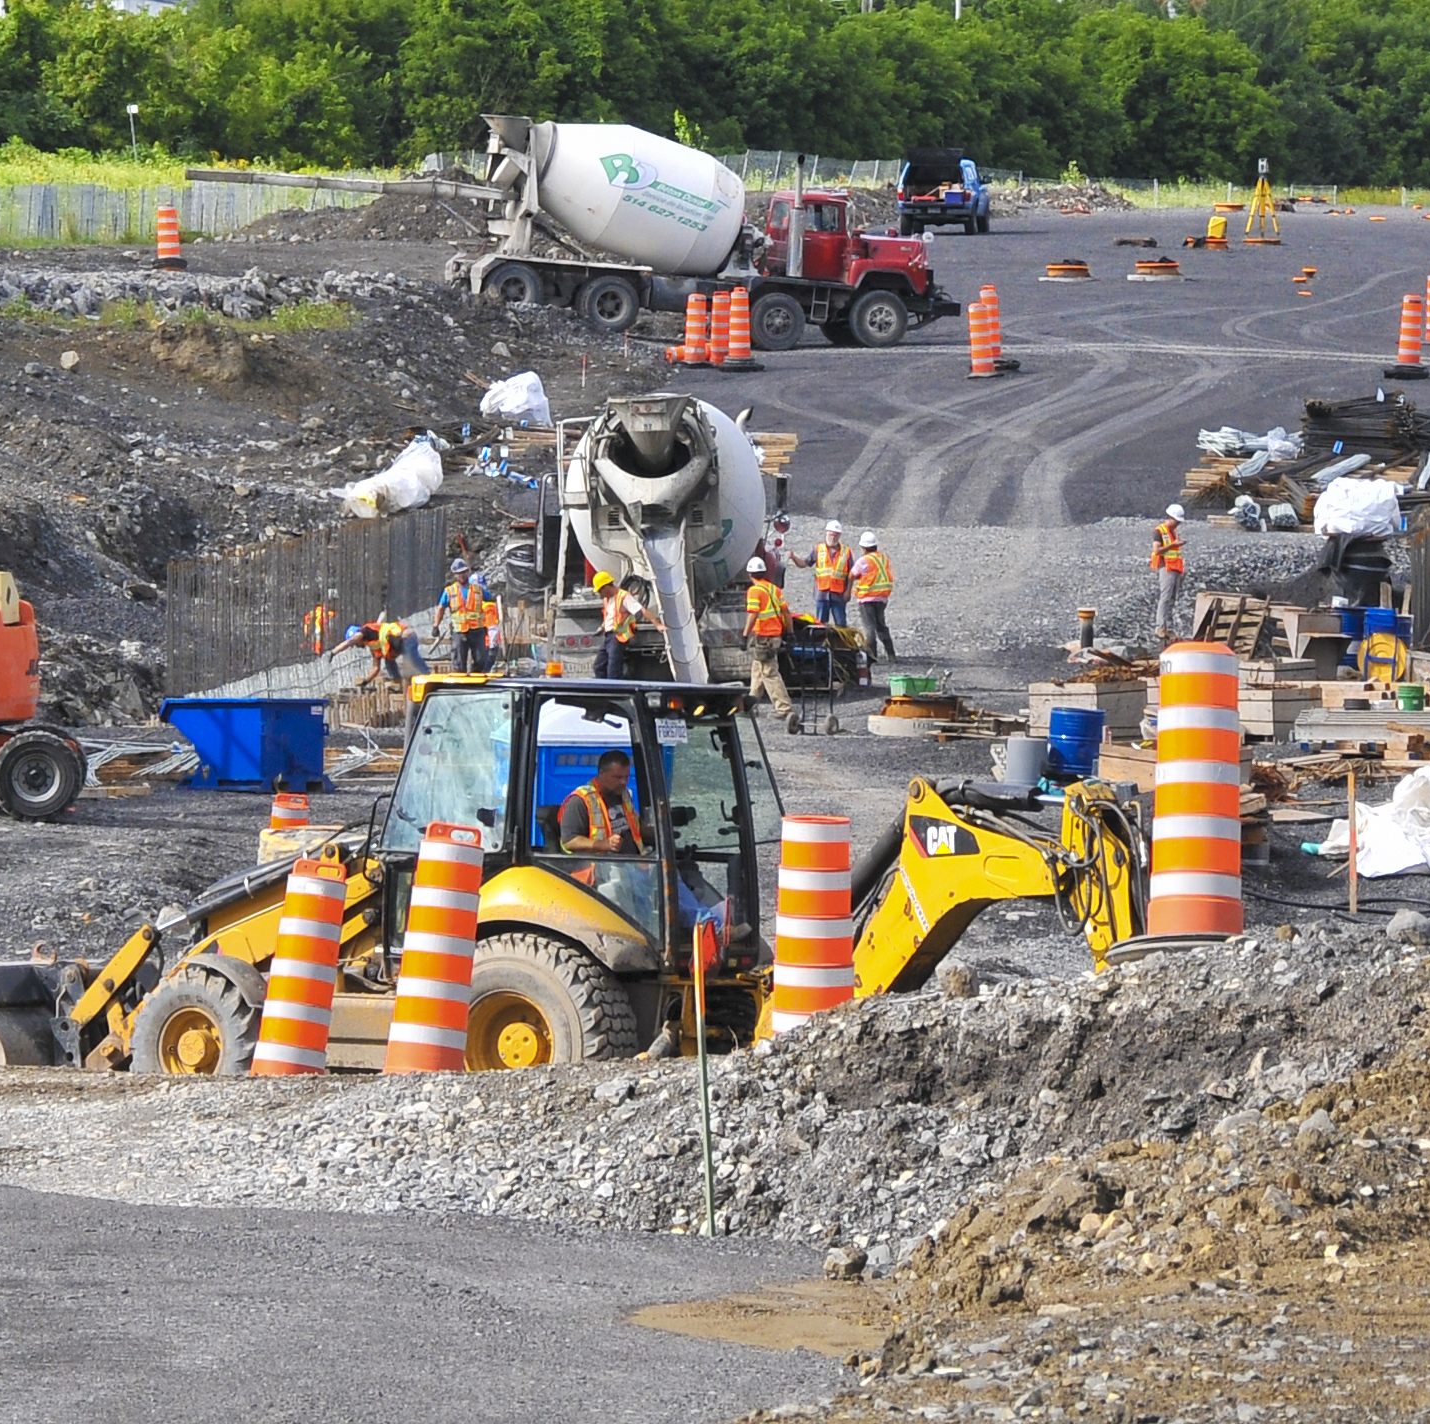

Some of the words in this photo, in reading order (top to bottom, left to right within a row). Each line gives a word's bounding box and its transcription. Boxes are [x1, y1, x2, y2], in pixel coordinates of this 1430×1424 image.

[622, 194, 647, 208] 514
[647, 204, 709, 232] 627-1253
[926, 825, 958, 855] CAT
